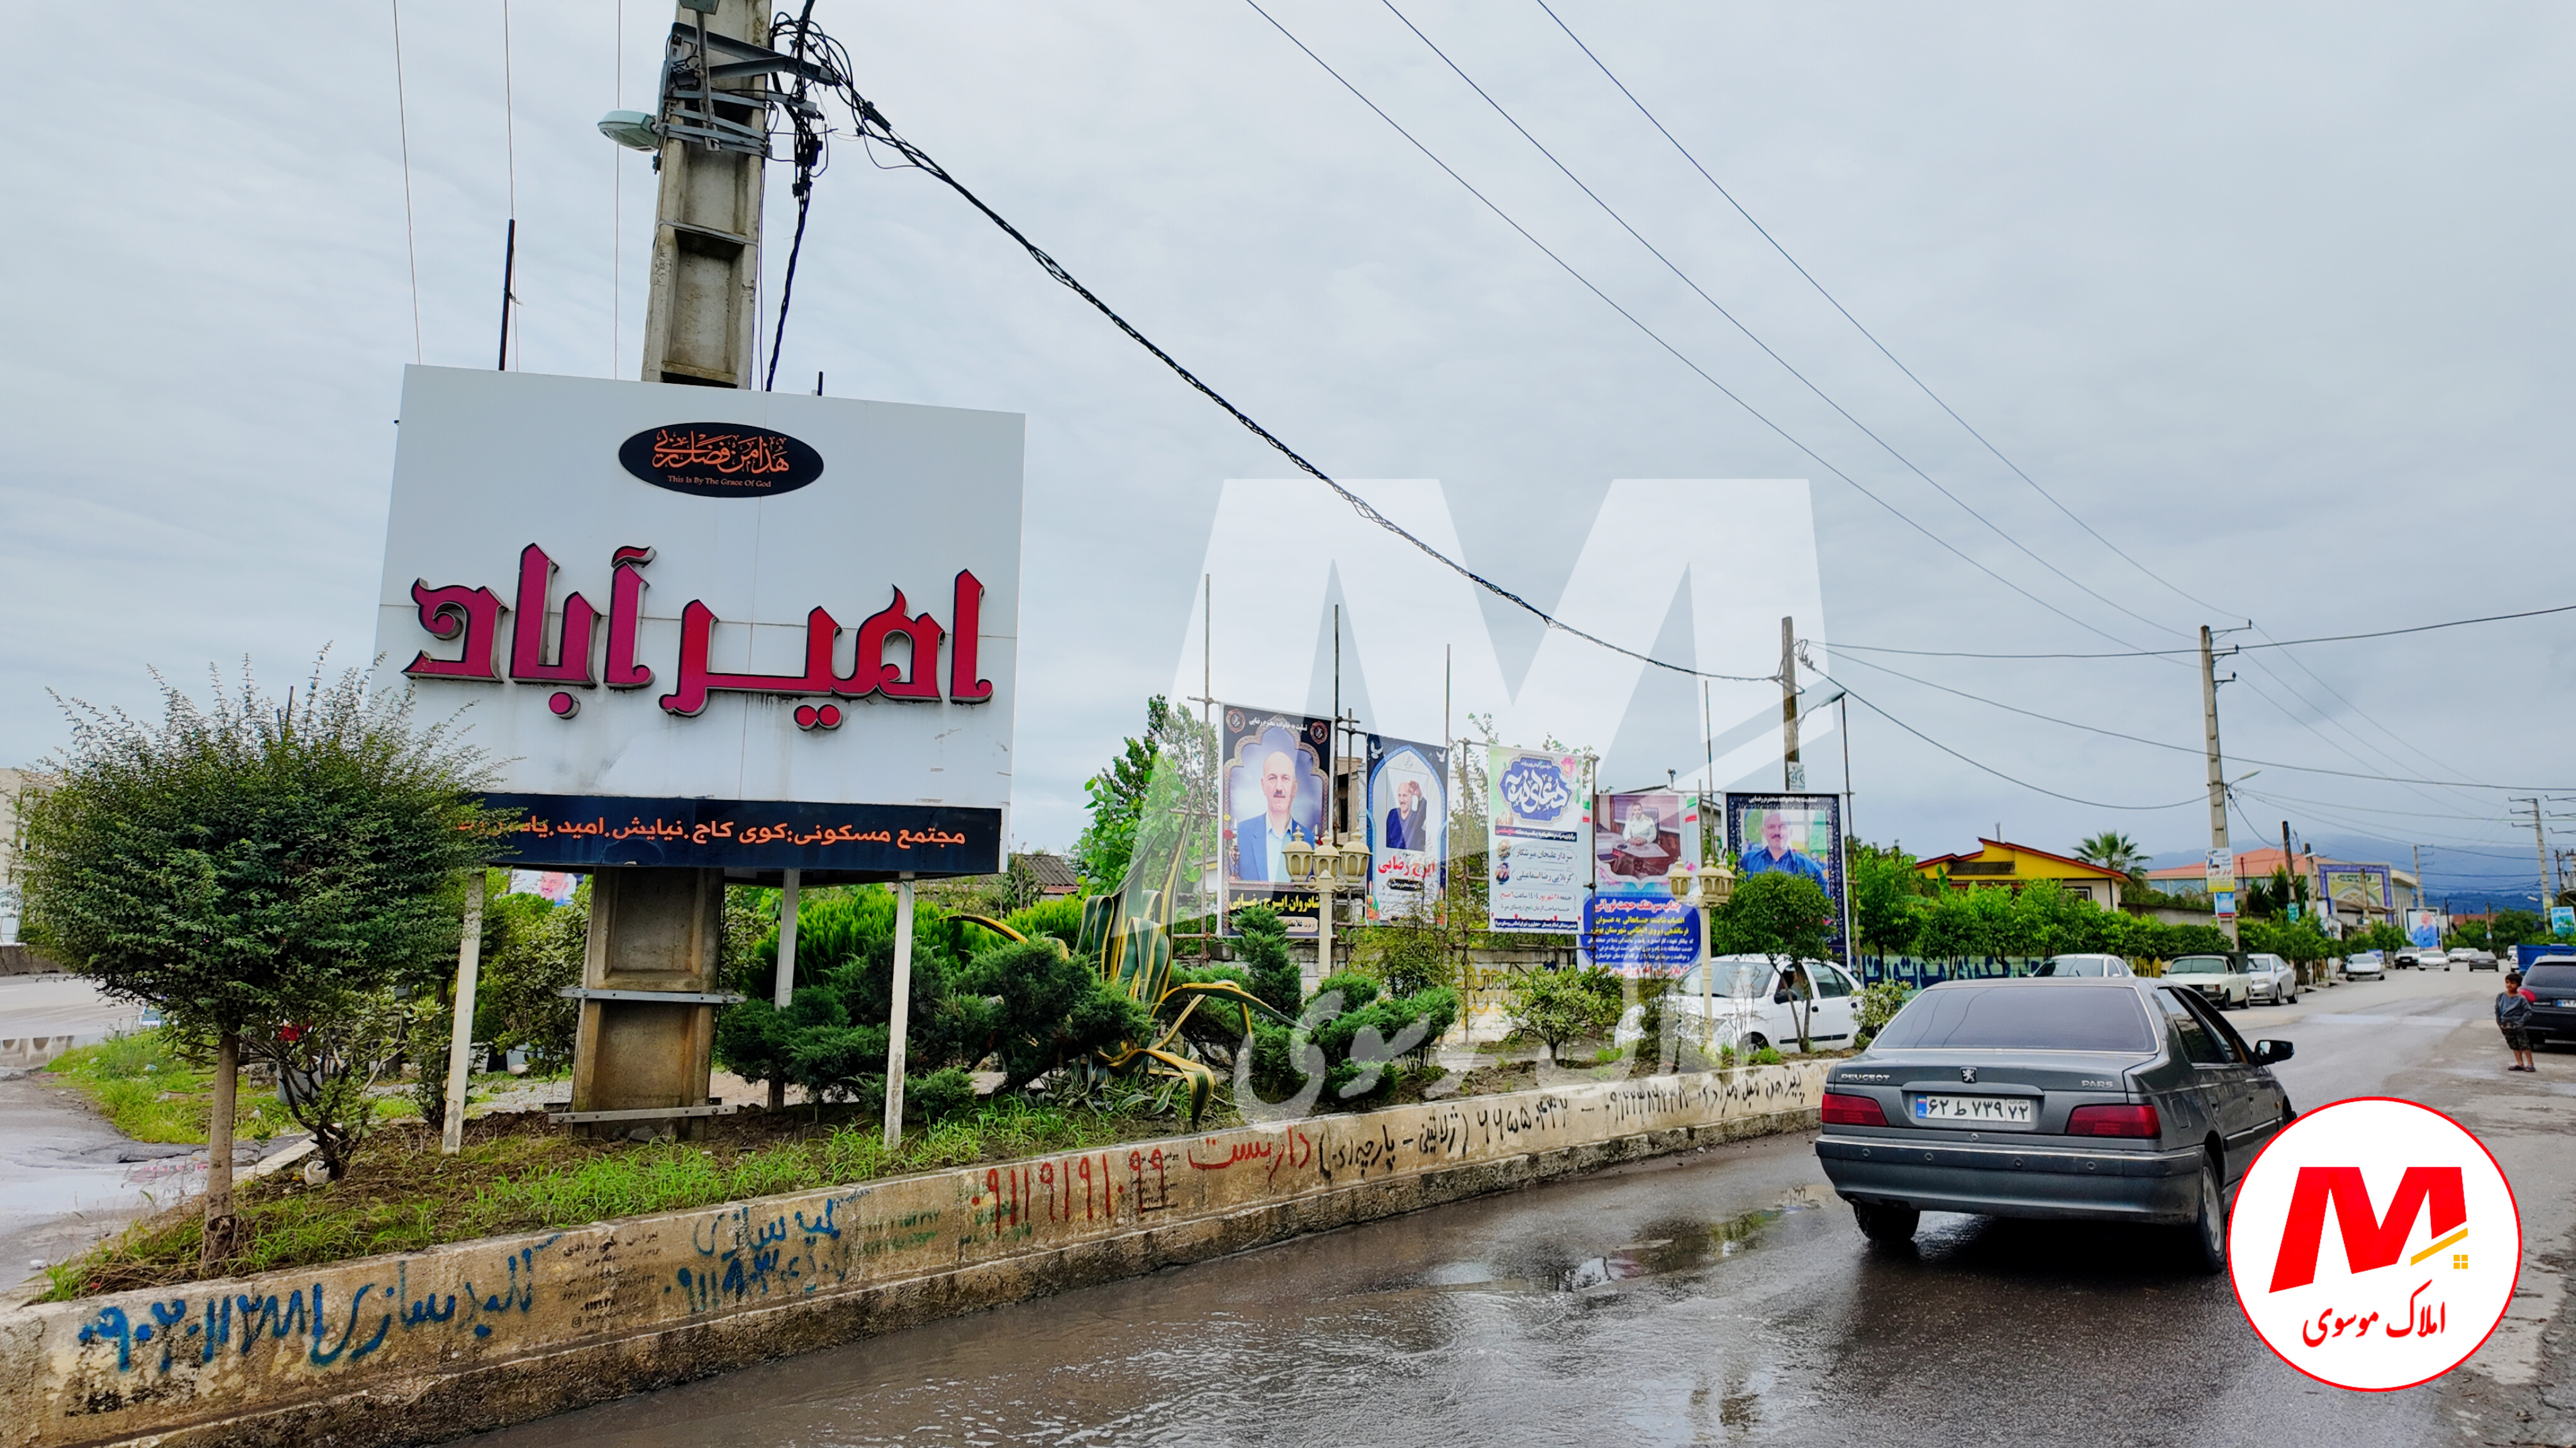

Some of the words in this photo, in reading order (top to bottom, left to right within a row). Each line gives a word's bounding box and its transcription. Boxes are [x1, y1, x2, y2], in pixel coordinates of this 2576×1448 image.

[667, 475, 684, 483] This
[694, 476, 704, 485] By
[721, 478, 743, 486] Grace
[738, 822, 788, 844] کوی
[896, 827, 966, 849] مجتمع
[1377, 855, 1410, 876] رضایی
[1594, 898, 1617, 913] نورانی
[1617, 900, 1636, 912] حجت
[1637, 899, 1662, 913] سرهنگ
[1663, 899, 1681, 913] جناب
[1841, 1073, 1890, 1081] PEUGEOT
[2081, 1080, 2113, 1089] PARS
